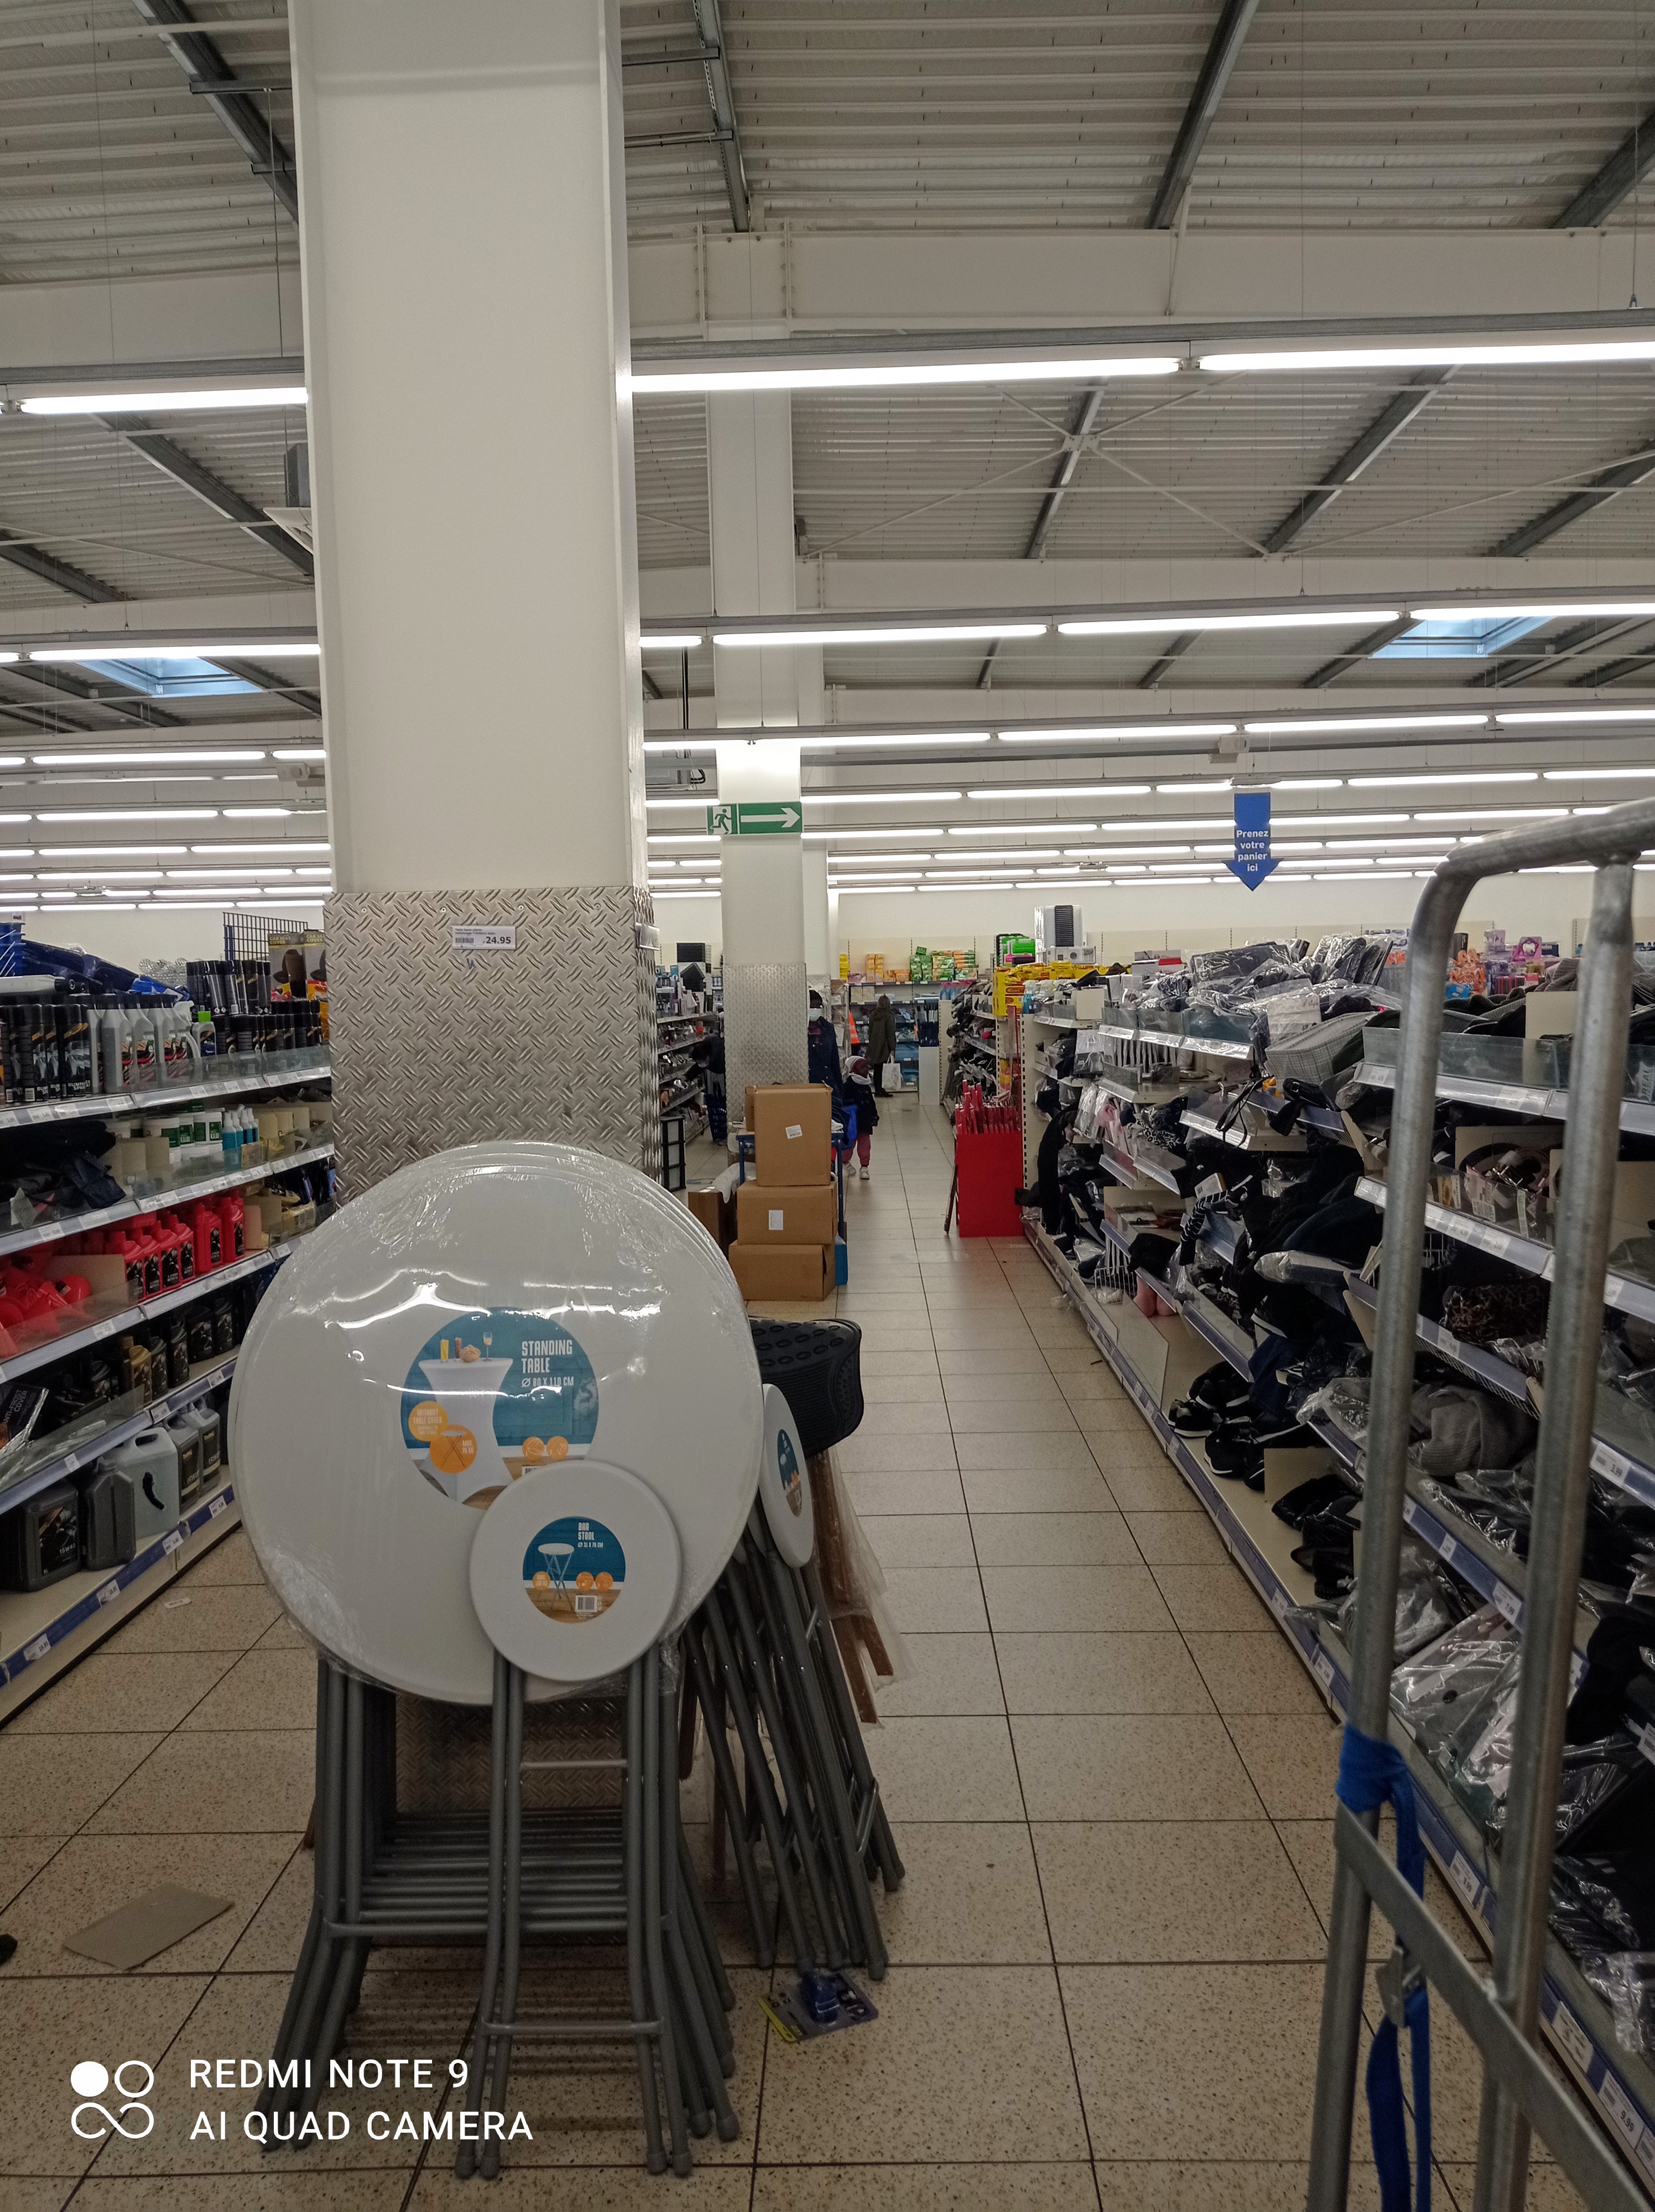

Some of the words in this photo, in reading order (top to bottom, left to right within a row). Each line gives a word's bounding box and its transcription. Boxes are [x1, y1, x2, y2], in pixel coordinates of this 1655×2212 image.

[1236, 830, 1268, 838] Prenez
[1238, 852, 1267, 862] panier
[522, 1339, 573, 1356] STANDING
[521, 1357, 550, 1374] TABLE
[533, 1378, 541, 1387] 80
[550, 1376, 561, 1387] 110
[563, 1376, 574, 1386] CM
[3, 1389, 21, 1423] NTI-FROST
[14, 1390, 28, 1412] COVER
[578, 1522, 589, 1531] BAR
[578, 1531, 595, 1540] STOOL
[1620, 2110, 1635, 2132] 9.99
